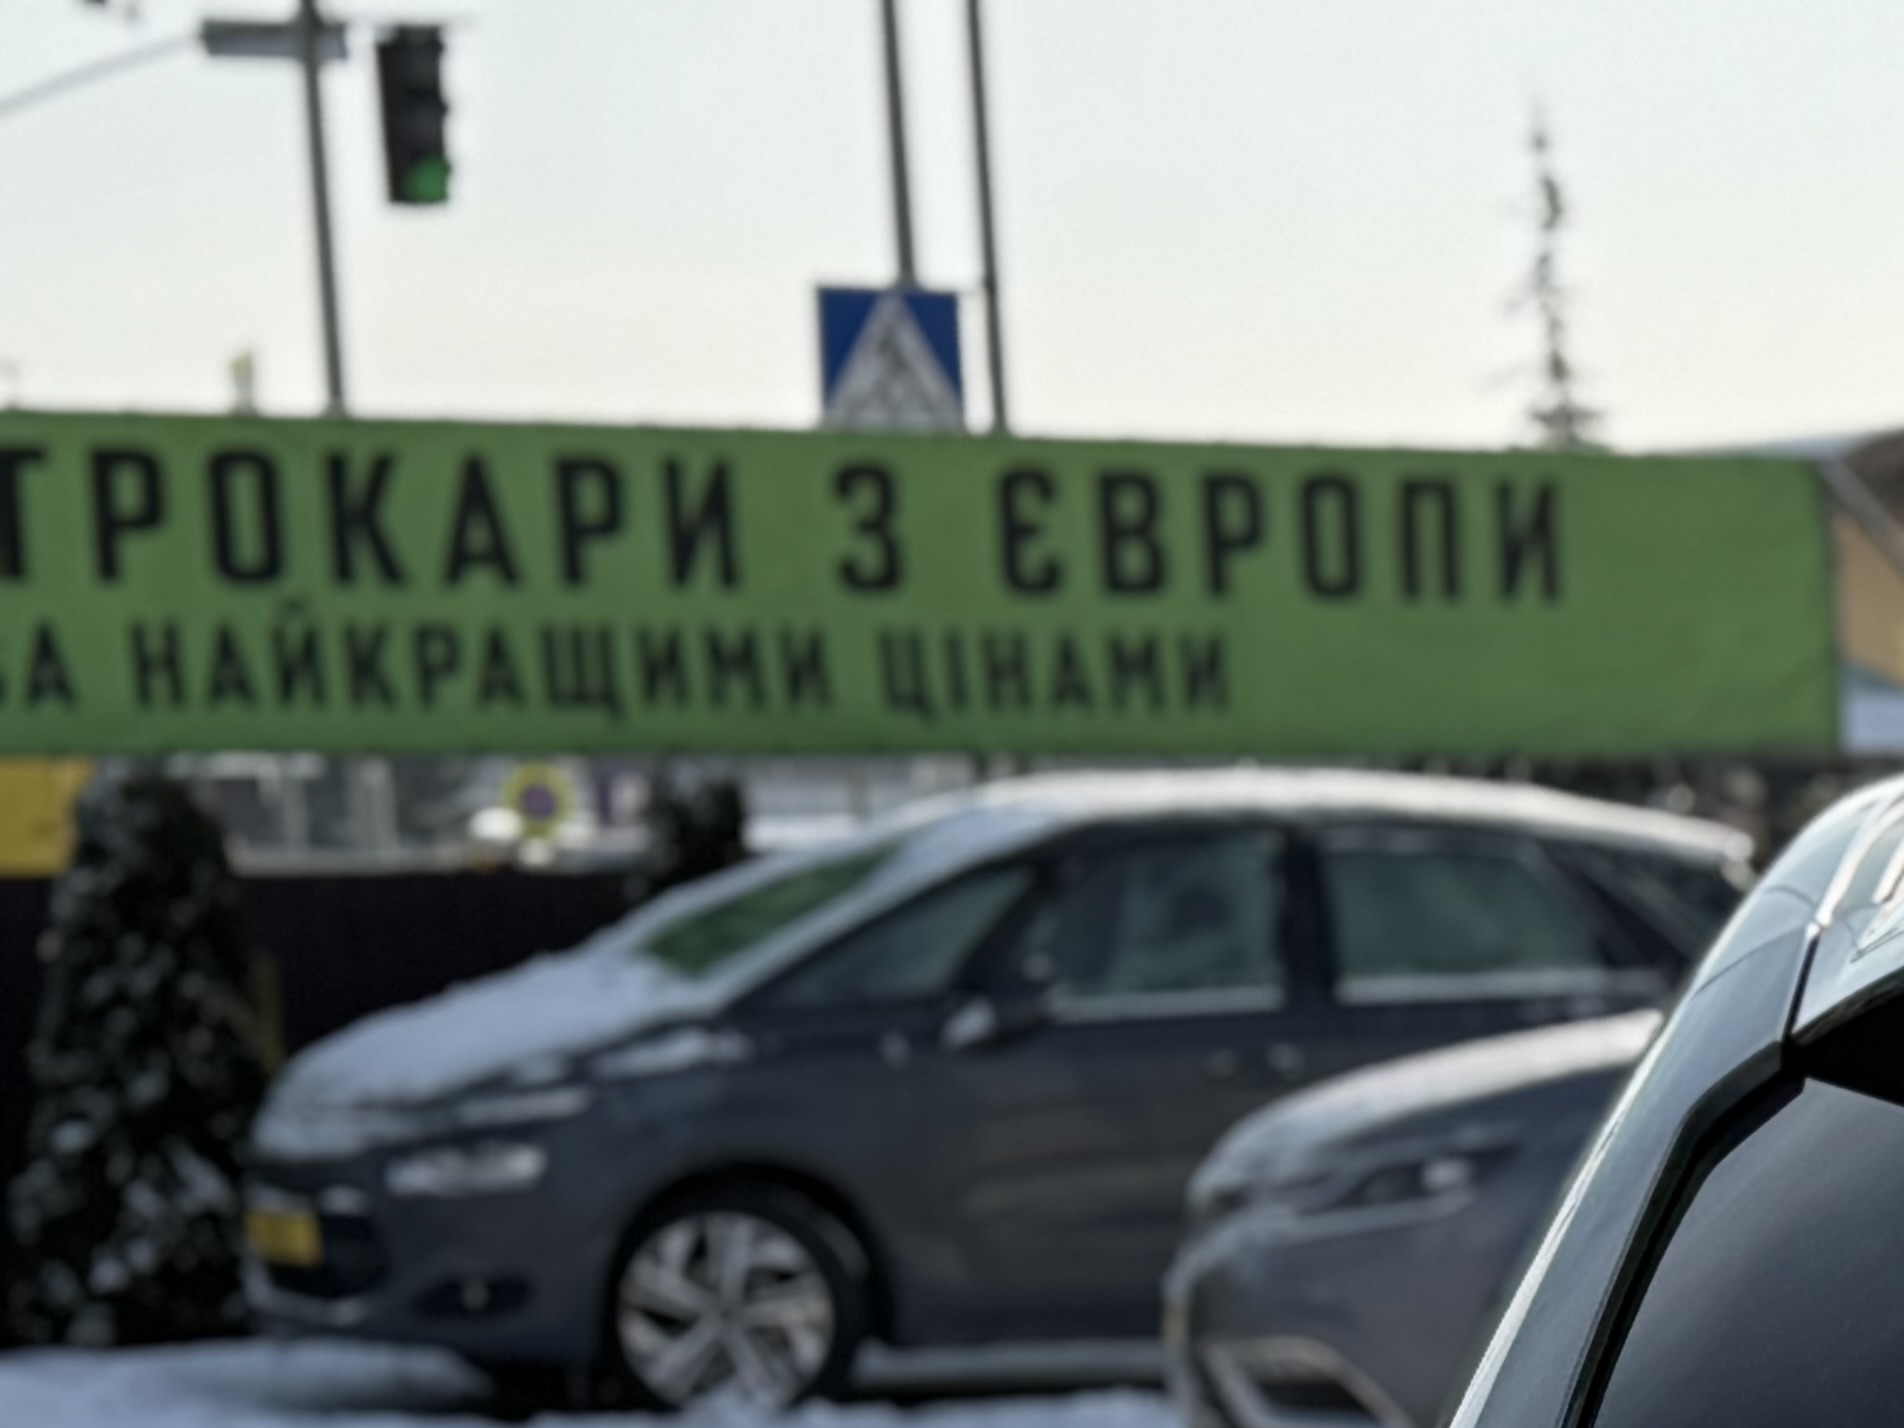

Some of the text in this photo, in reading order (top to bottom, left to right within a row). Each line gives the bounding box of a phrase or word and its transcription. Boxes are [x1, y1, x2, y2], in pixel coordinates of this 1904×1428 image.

[0, 443, 1560, 600] ТРОКАРИ З ЄВРОПИ
[0, 598, 1226, 720] А НАЙКРАЩИМИ ЦІНАМИ
